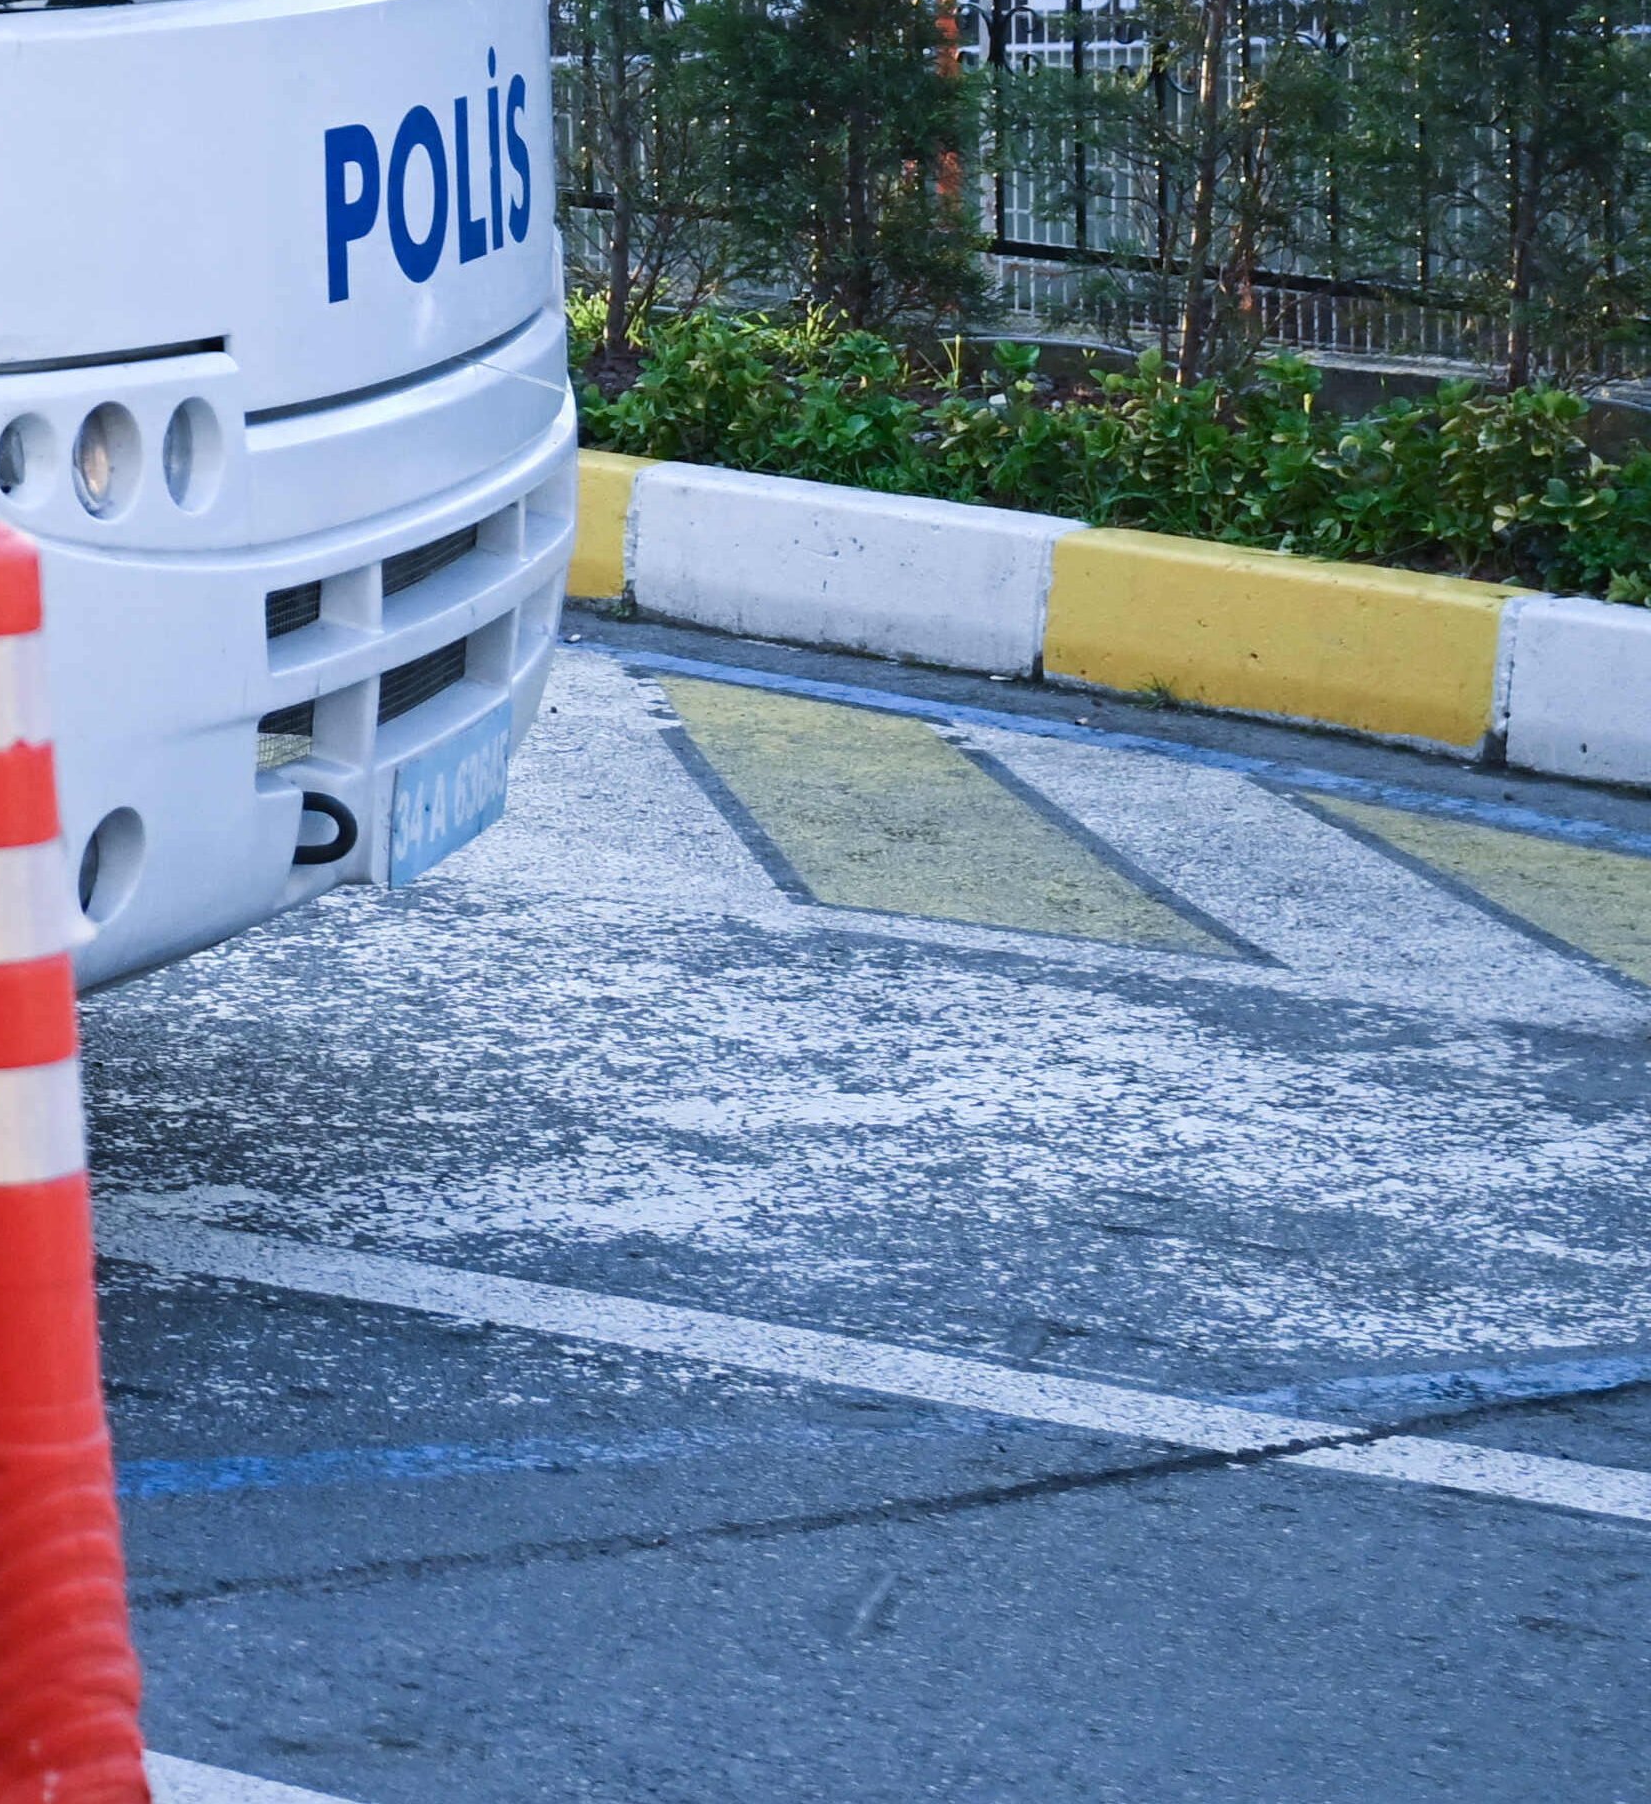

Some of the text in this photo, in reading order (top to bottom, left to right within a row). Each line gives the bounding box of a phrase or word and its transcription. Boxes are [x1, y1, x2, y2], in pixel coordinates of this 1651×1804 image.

[324, 45, 531, 304] POLİS
[394, 780, 424, 861] 34
[429, 772, 446, 843] A
